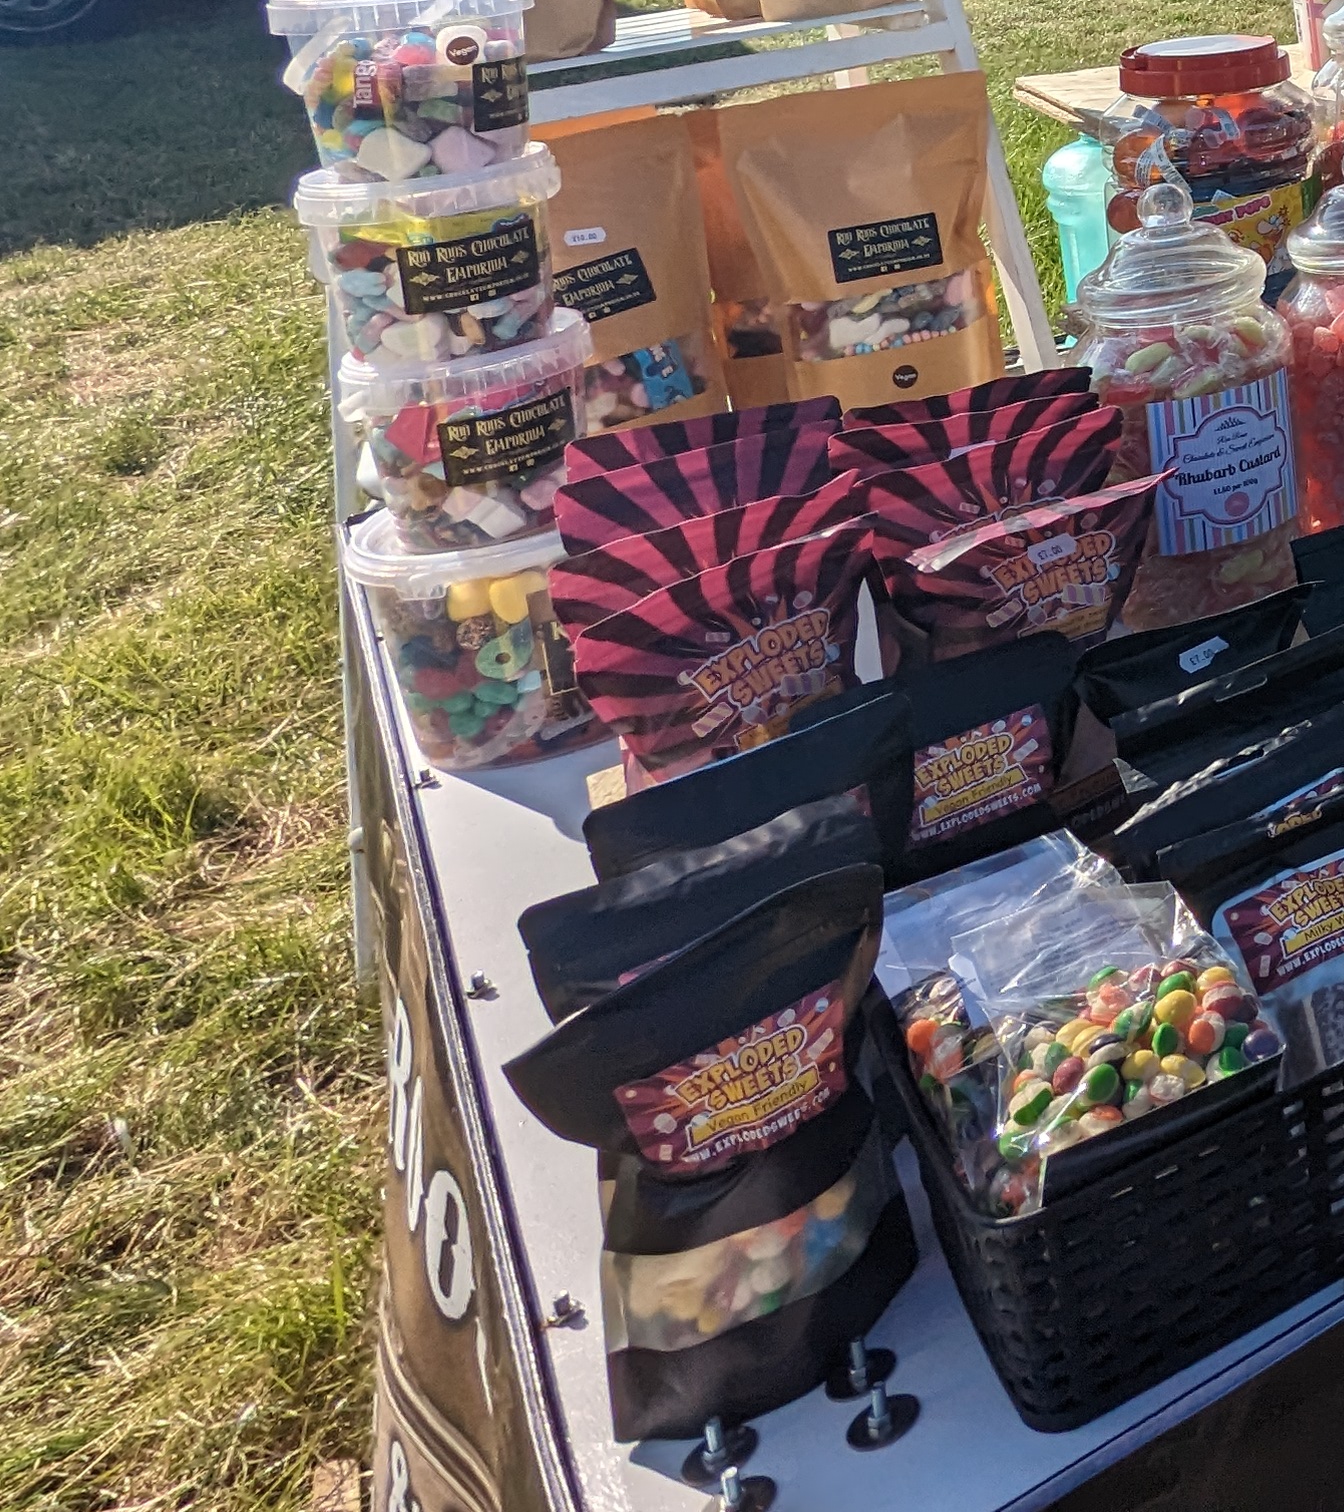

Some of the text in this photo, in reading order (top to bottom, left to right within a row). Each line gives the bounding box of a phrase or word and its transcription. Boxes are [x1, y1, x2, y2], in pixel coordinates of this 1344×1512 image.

[448, 44, 478, 58] Vegan
[471, 226, 530, 255] CHOCOLATE
[446, 256, 508, 284] EMPORIUM
[1174, 445, 1282, 487] Rhubarb Custard
[1022, 557, 1108, 606] SWEETS
[693, 608, 831, 701] EXPLODED
[730, 639, 827, 708] SWEETS
[916, 733, 1014, 789] EXPLODED
[936, 754, 1008, 796] SWEETS
[1304, 920, 1335, 941] Milky
[675, 1025, 807, 1107] EXPLODED
[706, 1056, 801, 1111] SWEETS
[706, 1109, 750, 1133] Vegan
[752, 1078, 810, 1118] Friendly
